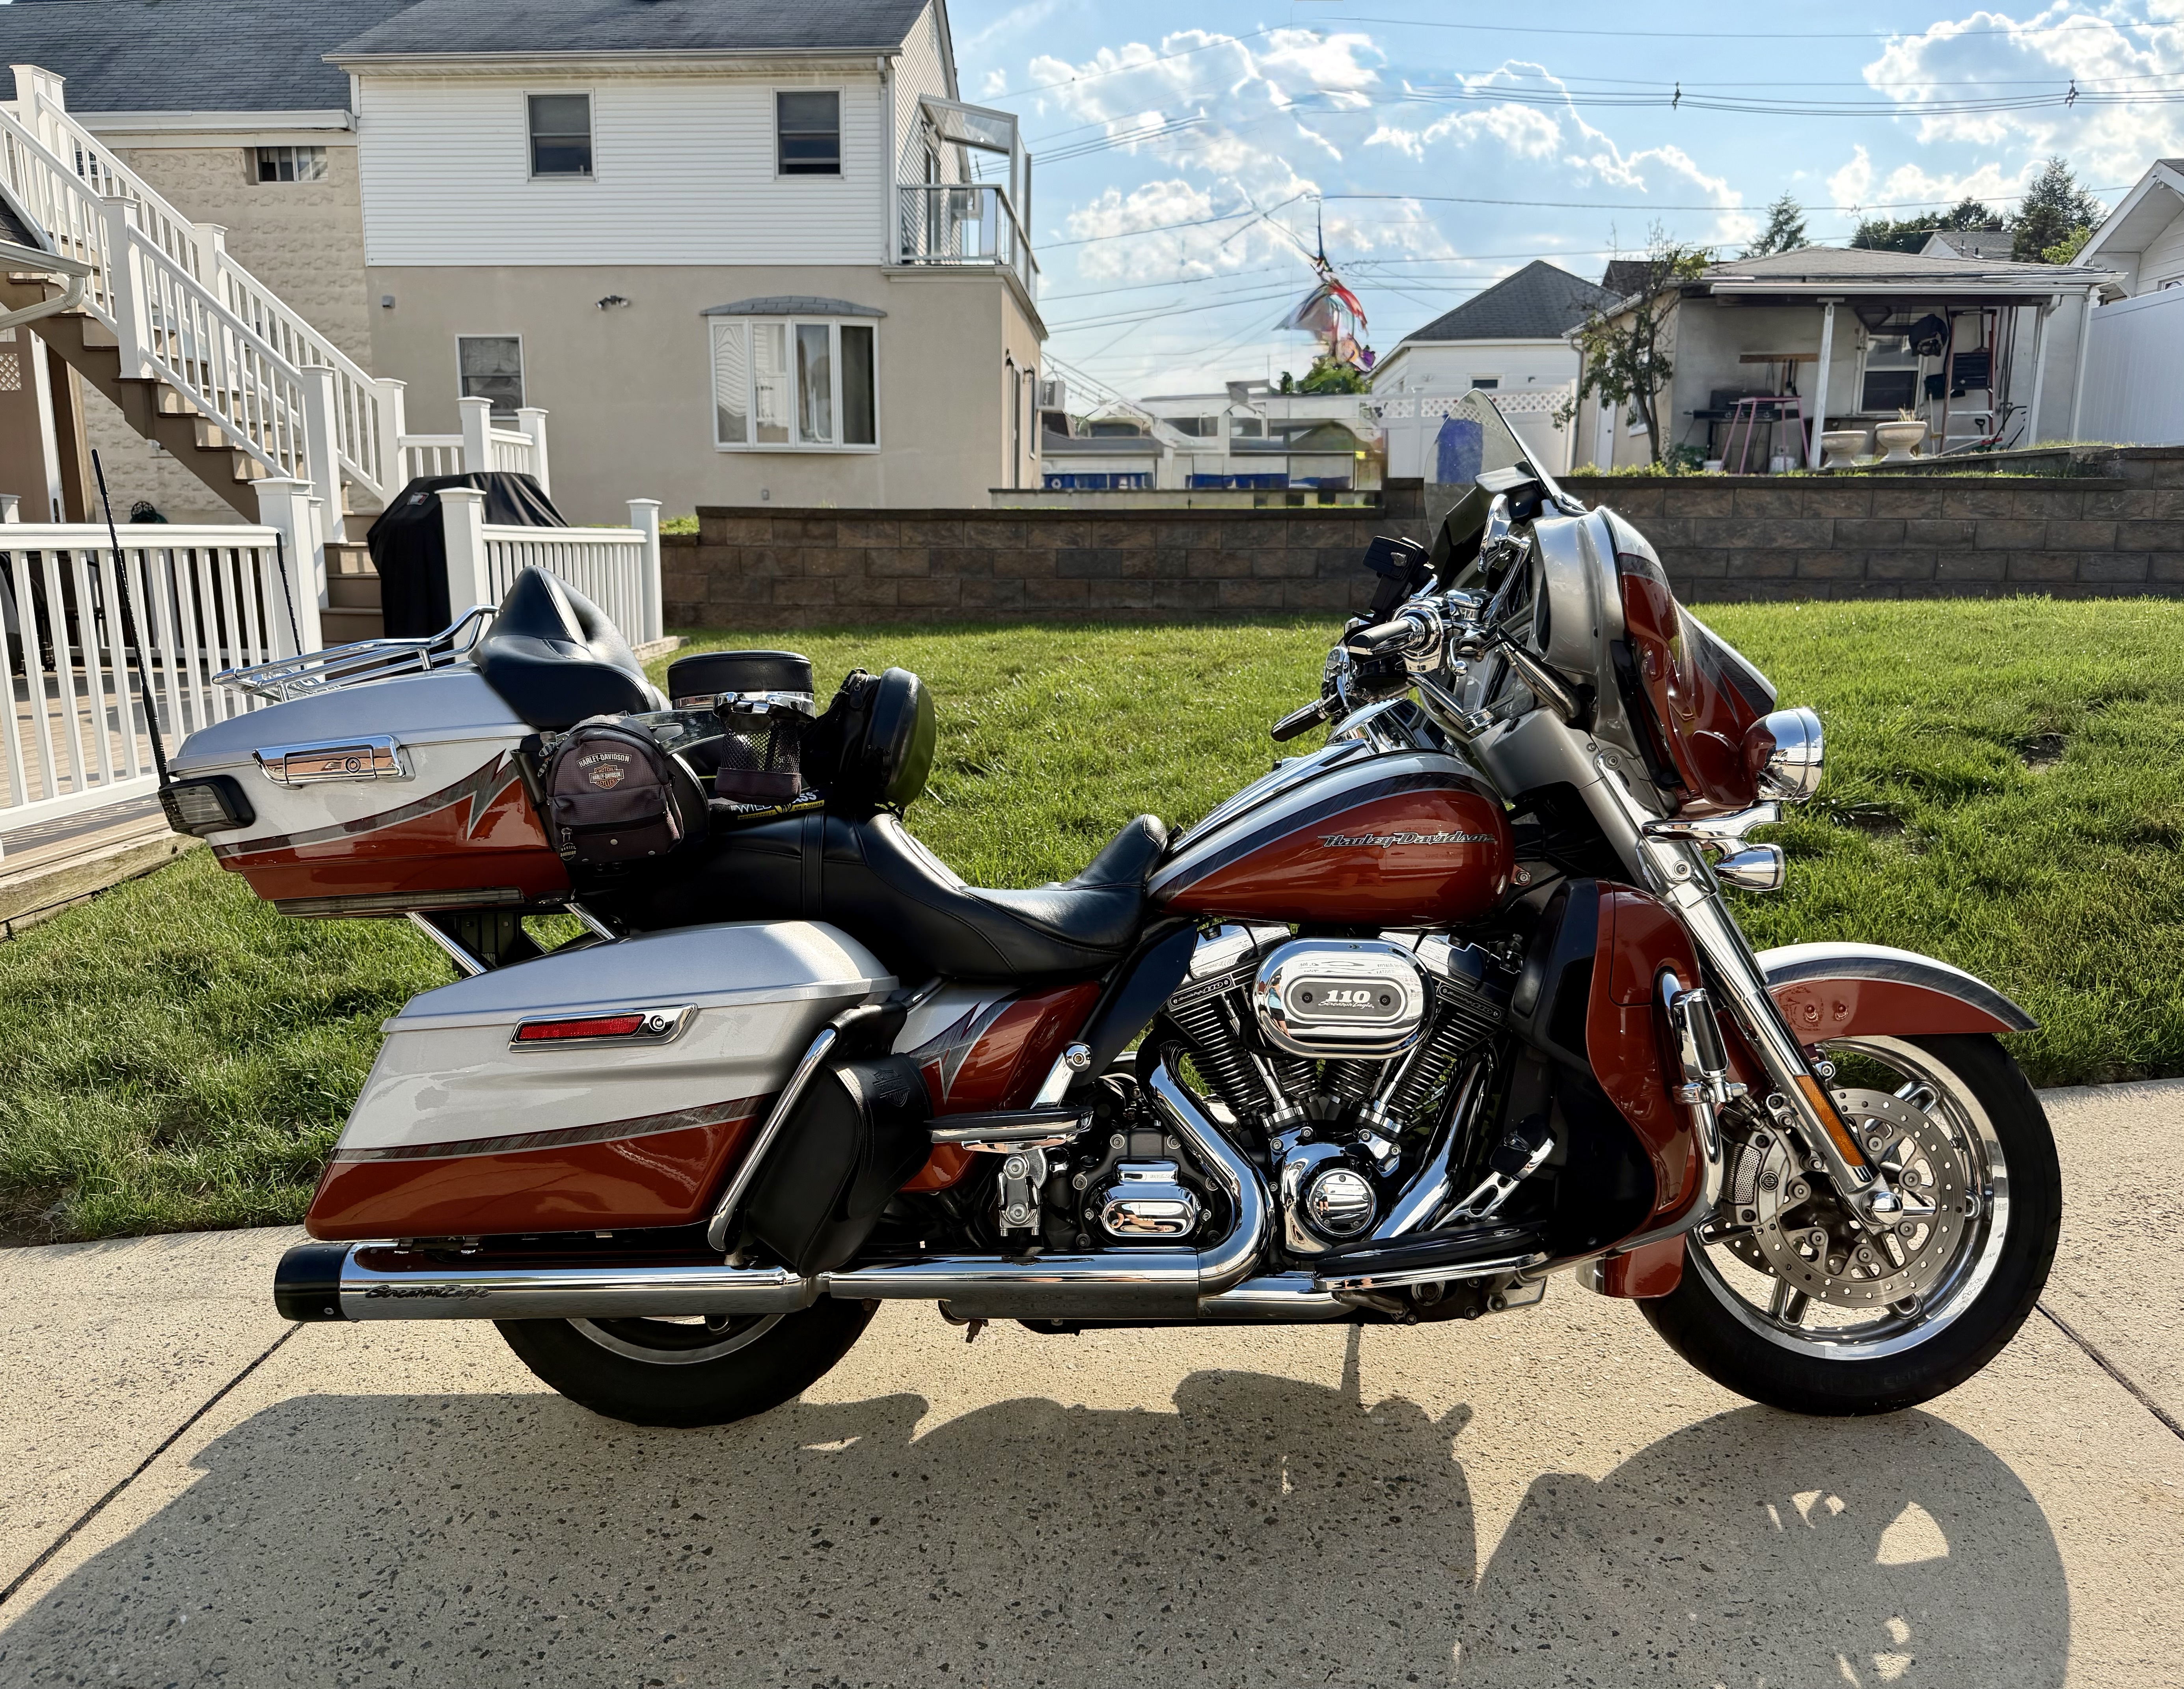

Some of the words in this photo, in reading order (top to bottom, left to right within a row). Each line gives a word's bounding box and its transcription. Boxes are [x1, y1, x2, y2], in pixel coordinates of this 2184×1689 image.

[578, 753, 630, 768] HARLEY-DAVIDSON
[592, 771, 621, 780] HARLEY-DAVIDSON
[1317, 831, 1496, 848] Harley-Davidson
[1325, 990, 1371, 1004] 110
